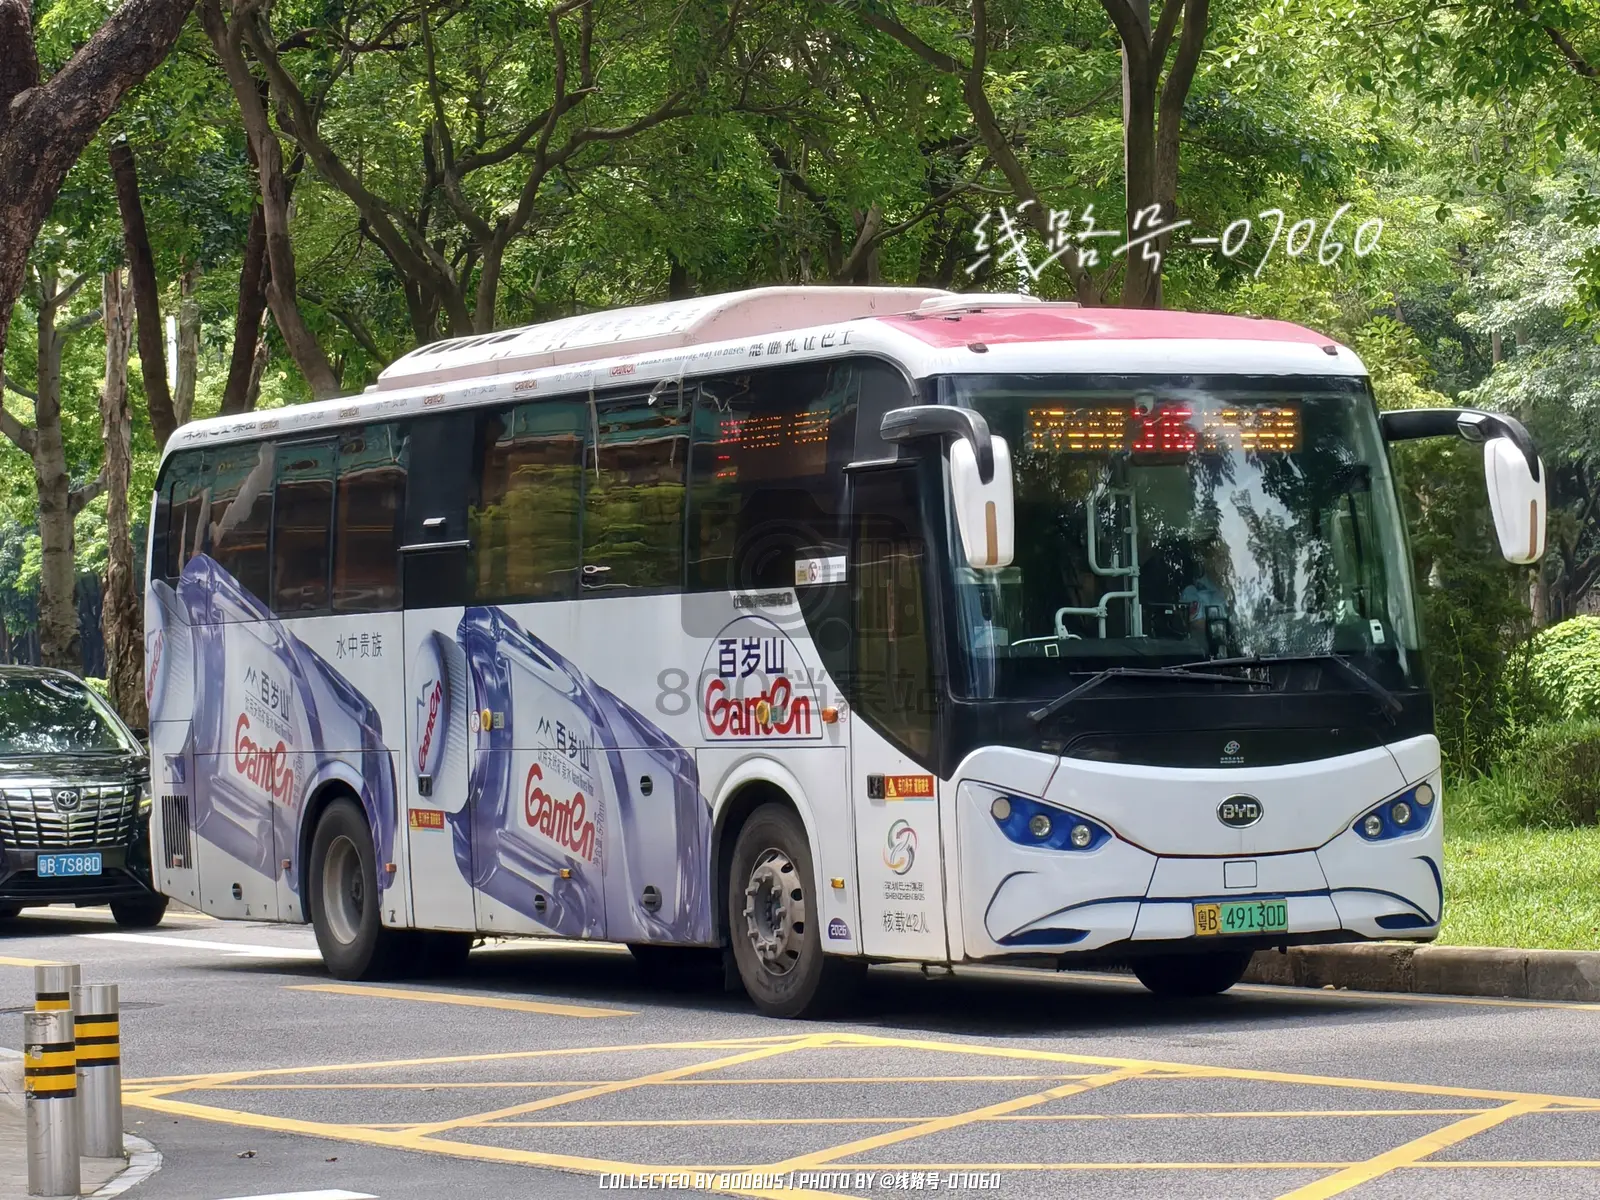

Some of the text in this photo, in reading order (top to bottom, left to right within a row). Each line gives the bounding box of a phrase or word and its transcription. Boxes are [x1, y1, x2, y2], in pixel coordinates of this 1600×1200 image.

[336, 632, 383, 660] 水中贵族
[717, 637, 785, 678] 百岁山
[260, 670, 292, 722] 百岁山
[235, 712, 294, 808] Ganten
[556, 720, 590, 772] 百岁山
[525, 763, 595, 862] Ganten
[1223, 804, 1257, 818] BYD
